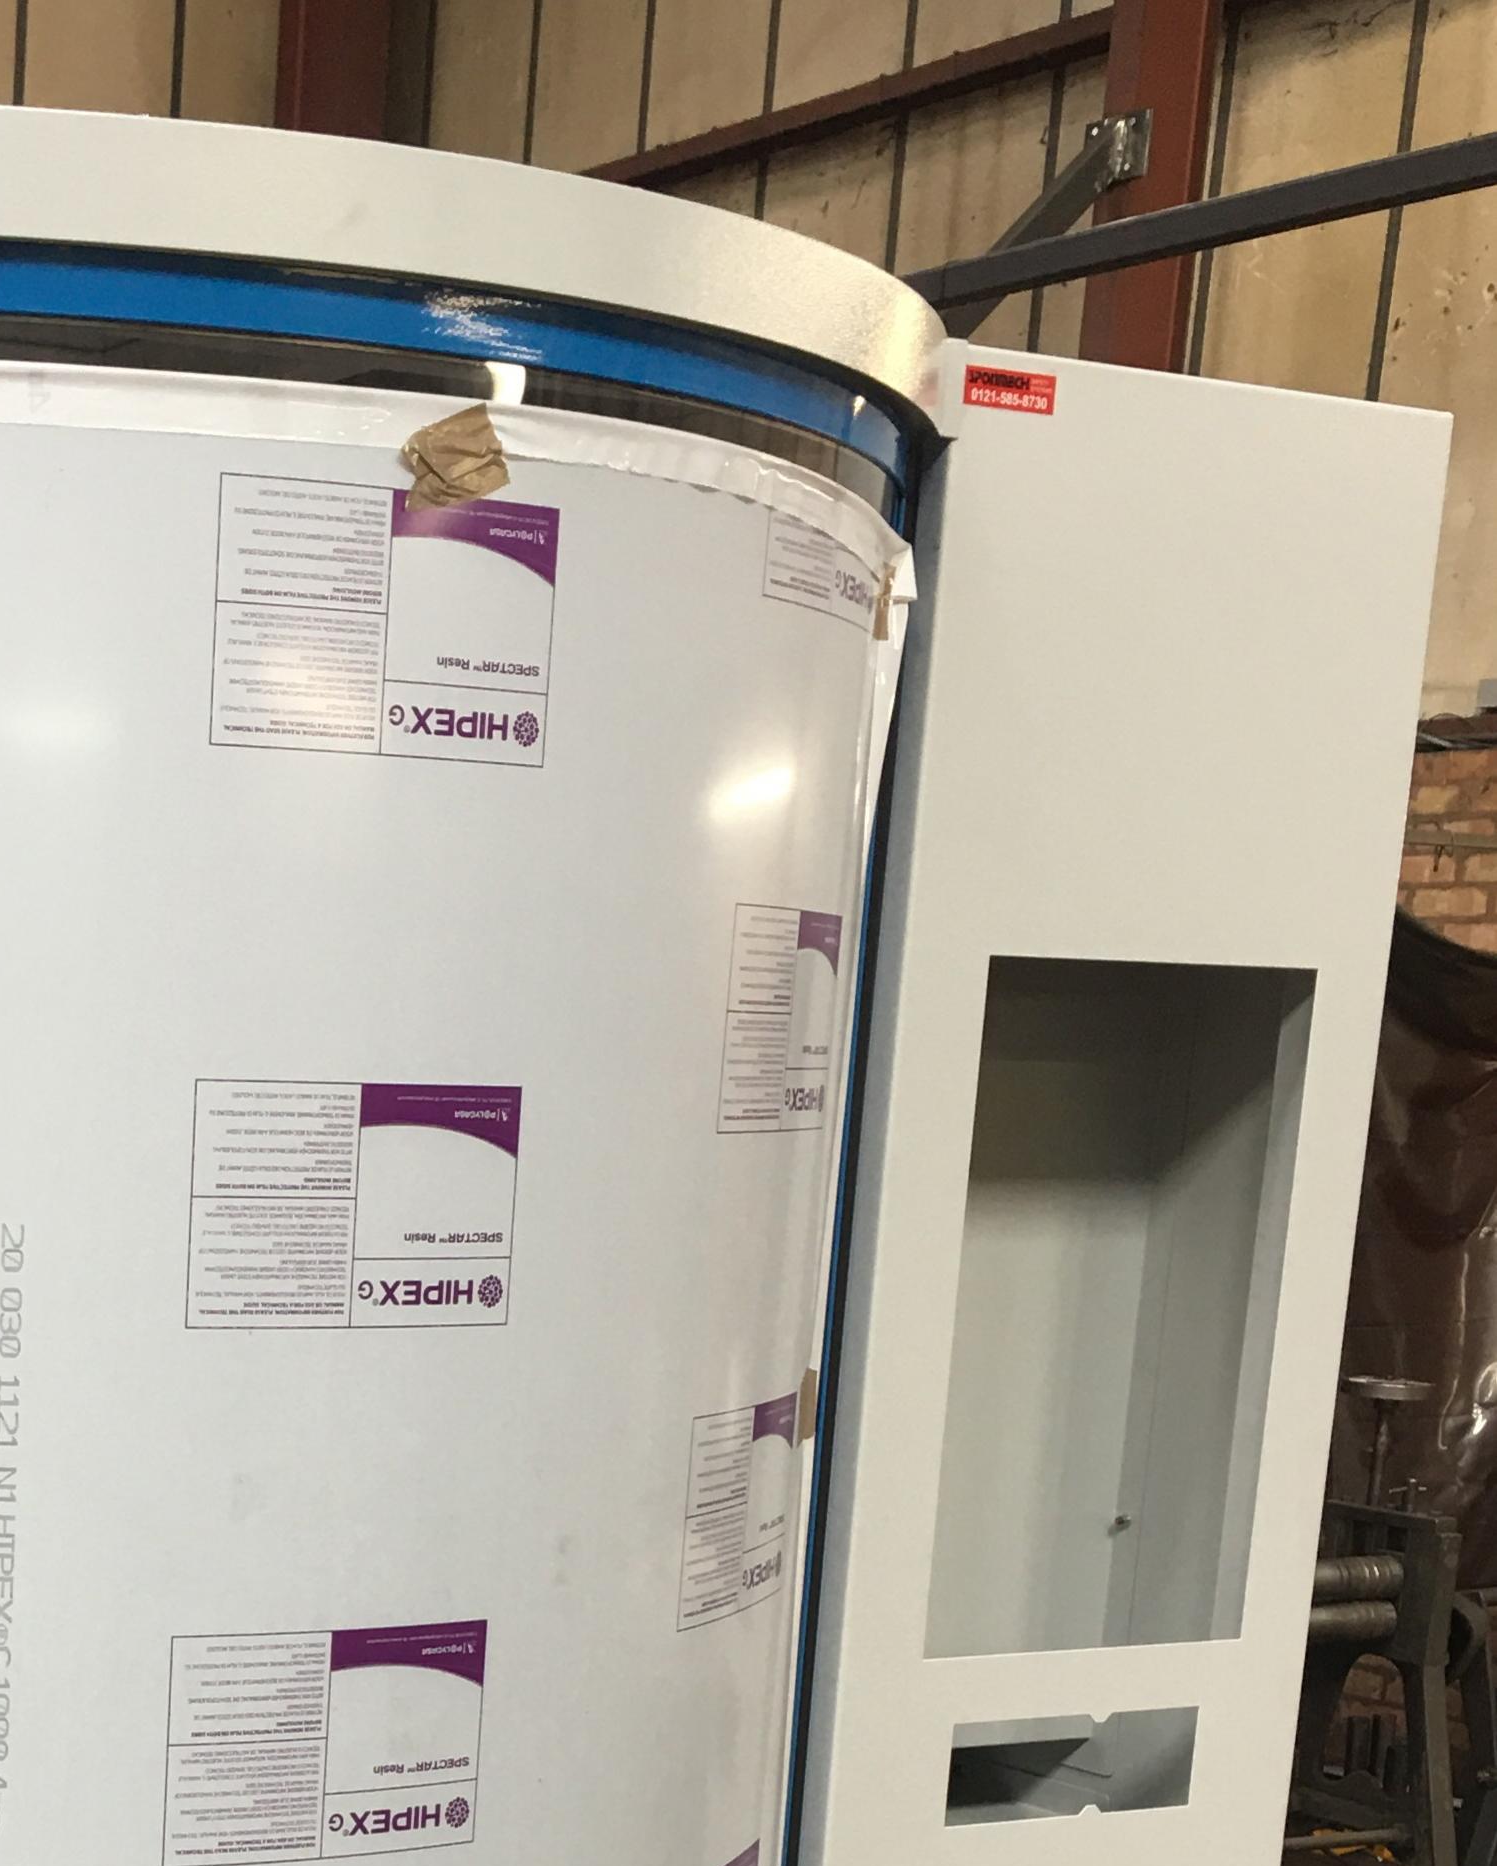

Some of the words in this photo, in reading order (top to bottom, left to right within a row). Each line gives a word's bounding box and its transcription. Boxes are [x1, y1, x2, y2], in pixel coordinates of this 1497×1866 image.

[971, 387, 1048, 409] 0121-585-8730
[437, 657, 470, 670] Resin
[389, 705, 405, 724] G
[404, 1233, 436, 1243] Resin
[1, 1223, 24, 1272] 20
[358, 1280, 373, 1294] G
[373, 1764, 404, 1775] Resin
[329, 1814, 345, 1829] G
